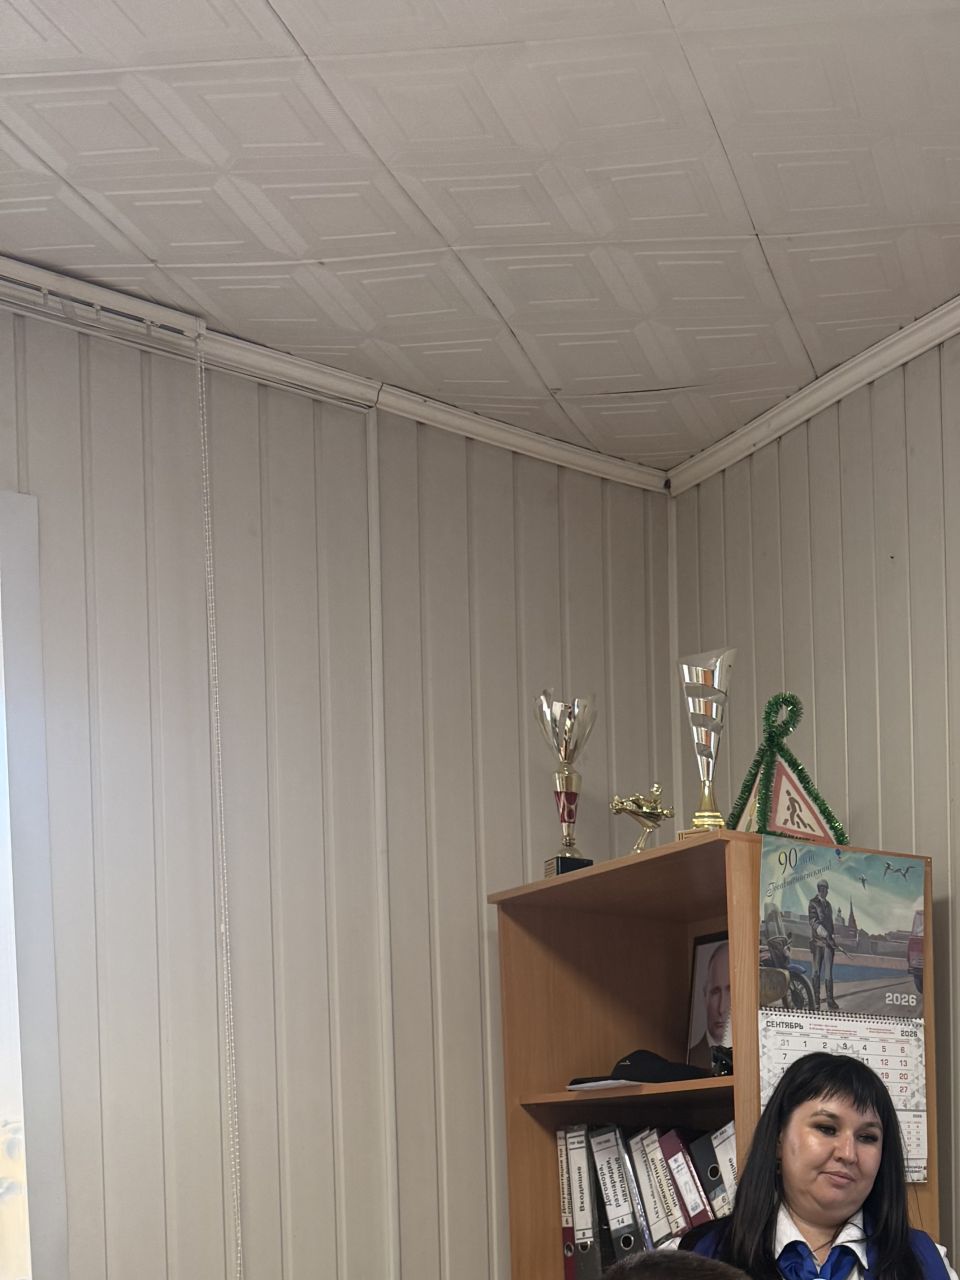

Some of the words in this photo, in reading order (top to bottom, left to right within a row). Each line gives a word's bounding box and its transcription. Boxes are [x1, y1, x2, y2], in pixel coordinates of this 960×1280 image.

[778, 847, 797, 875] 90
[885, 992, 917, 1006] 2026
[766, 1020, 804, 1030] СЕНТЯБРЬ
[900, 1030, 918, 1038] 2026
[842, 1042, 848, 1050] 3
[881, 1045, 887, 1053] 5
[880, 1072, 890, 1080] 19
[576, 1166, 585, 1212] Входящие
[599, 1163, 613, 1206] Договора,
[606, 1157, 622, 1208] разнарядки,
[614, 1157, 629, 1204] накладные
[650, 1157, 674, 1217] Должностные
[658, 1157, 678, 1208] инструкции
